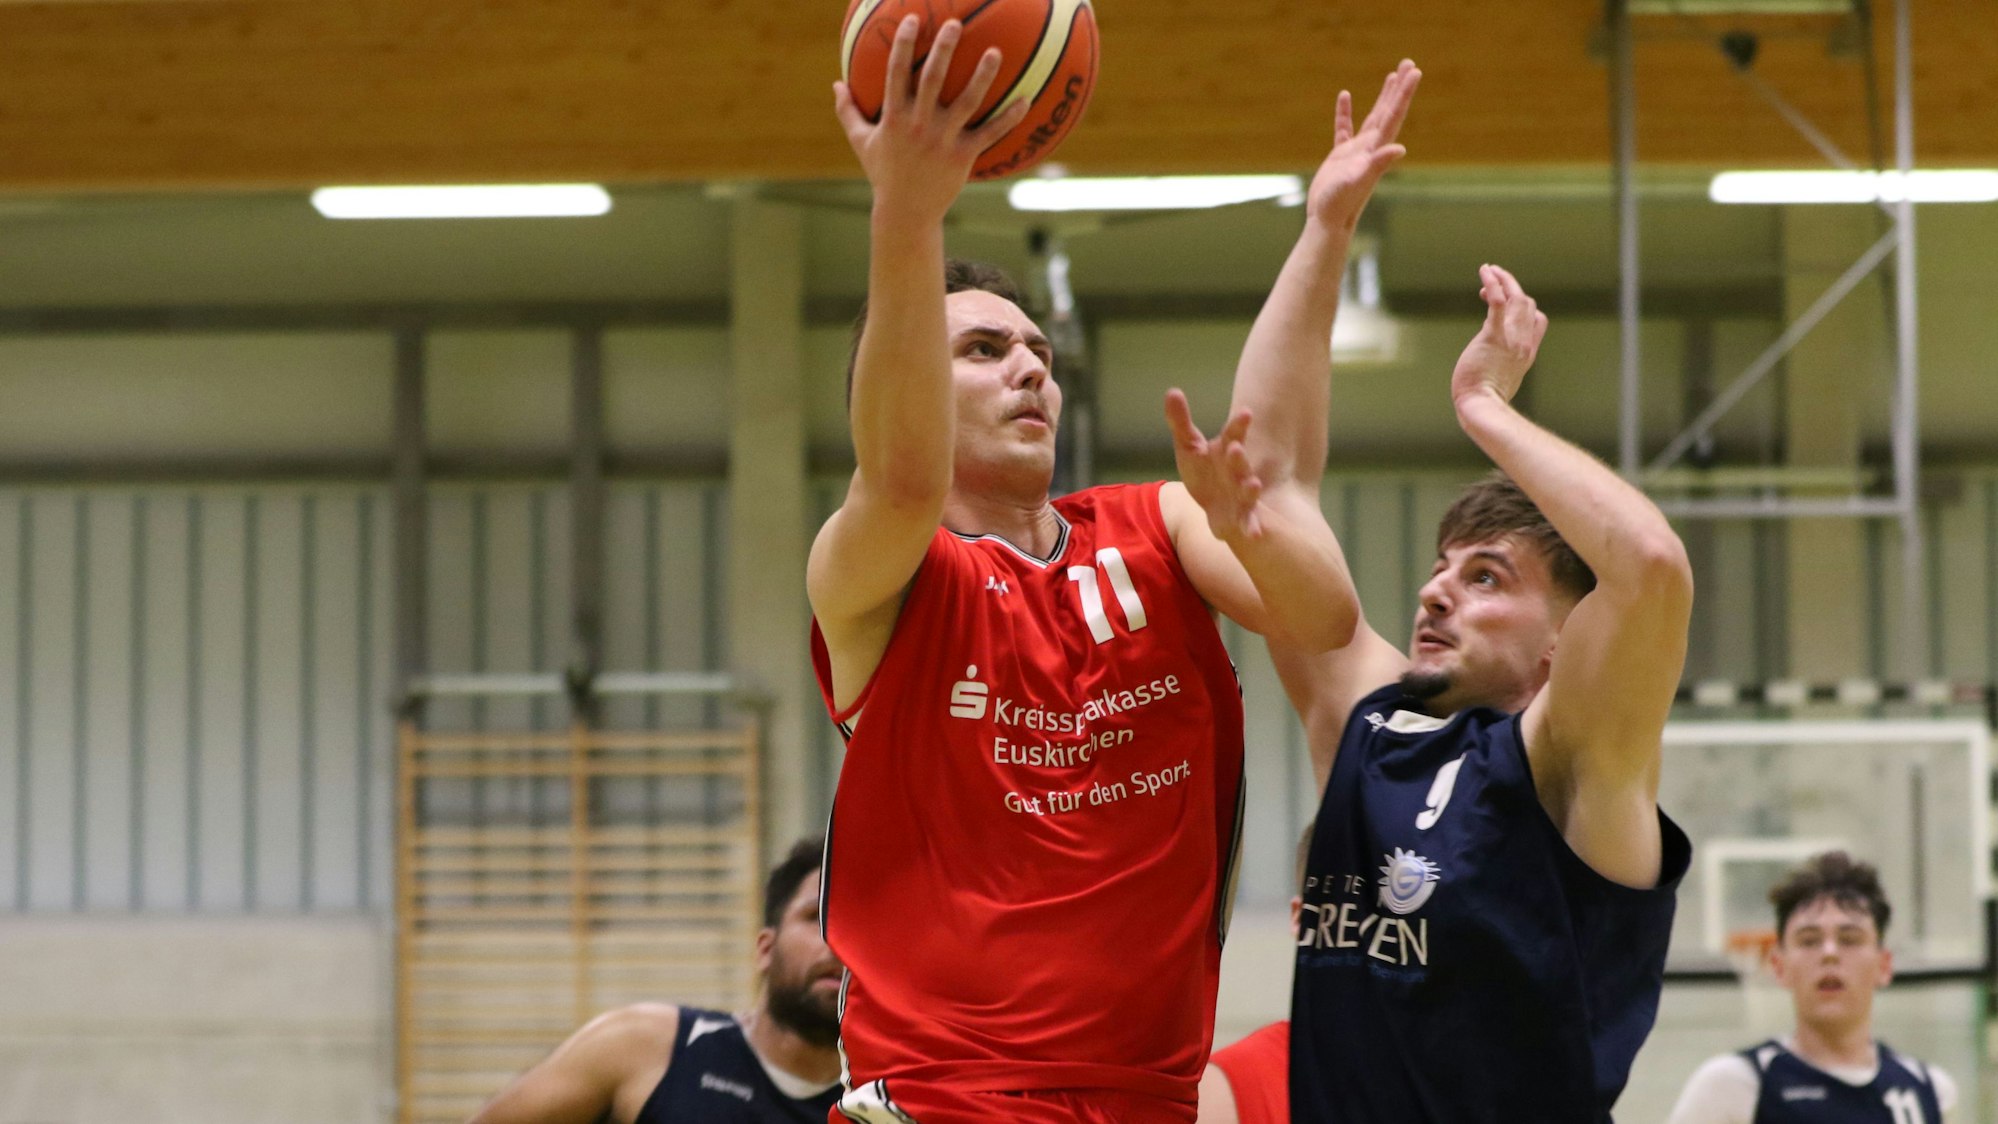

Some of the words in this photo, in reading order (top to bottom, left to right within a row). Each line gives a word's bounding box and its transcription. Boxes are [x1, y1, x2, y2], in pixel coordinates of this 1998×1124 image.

[1067, 547, 1147, 645] 11
[994, 674, 1181, 736] Kreissparkasse
[1004, 791, 1045, 816] Gut
[1047, 791, 1083, 814] für
[1089, 782, 1127, 806] den
[1415, 752, 1467, 831] 9
